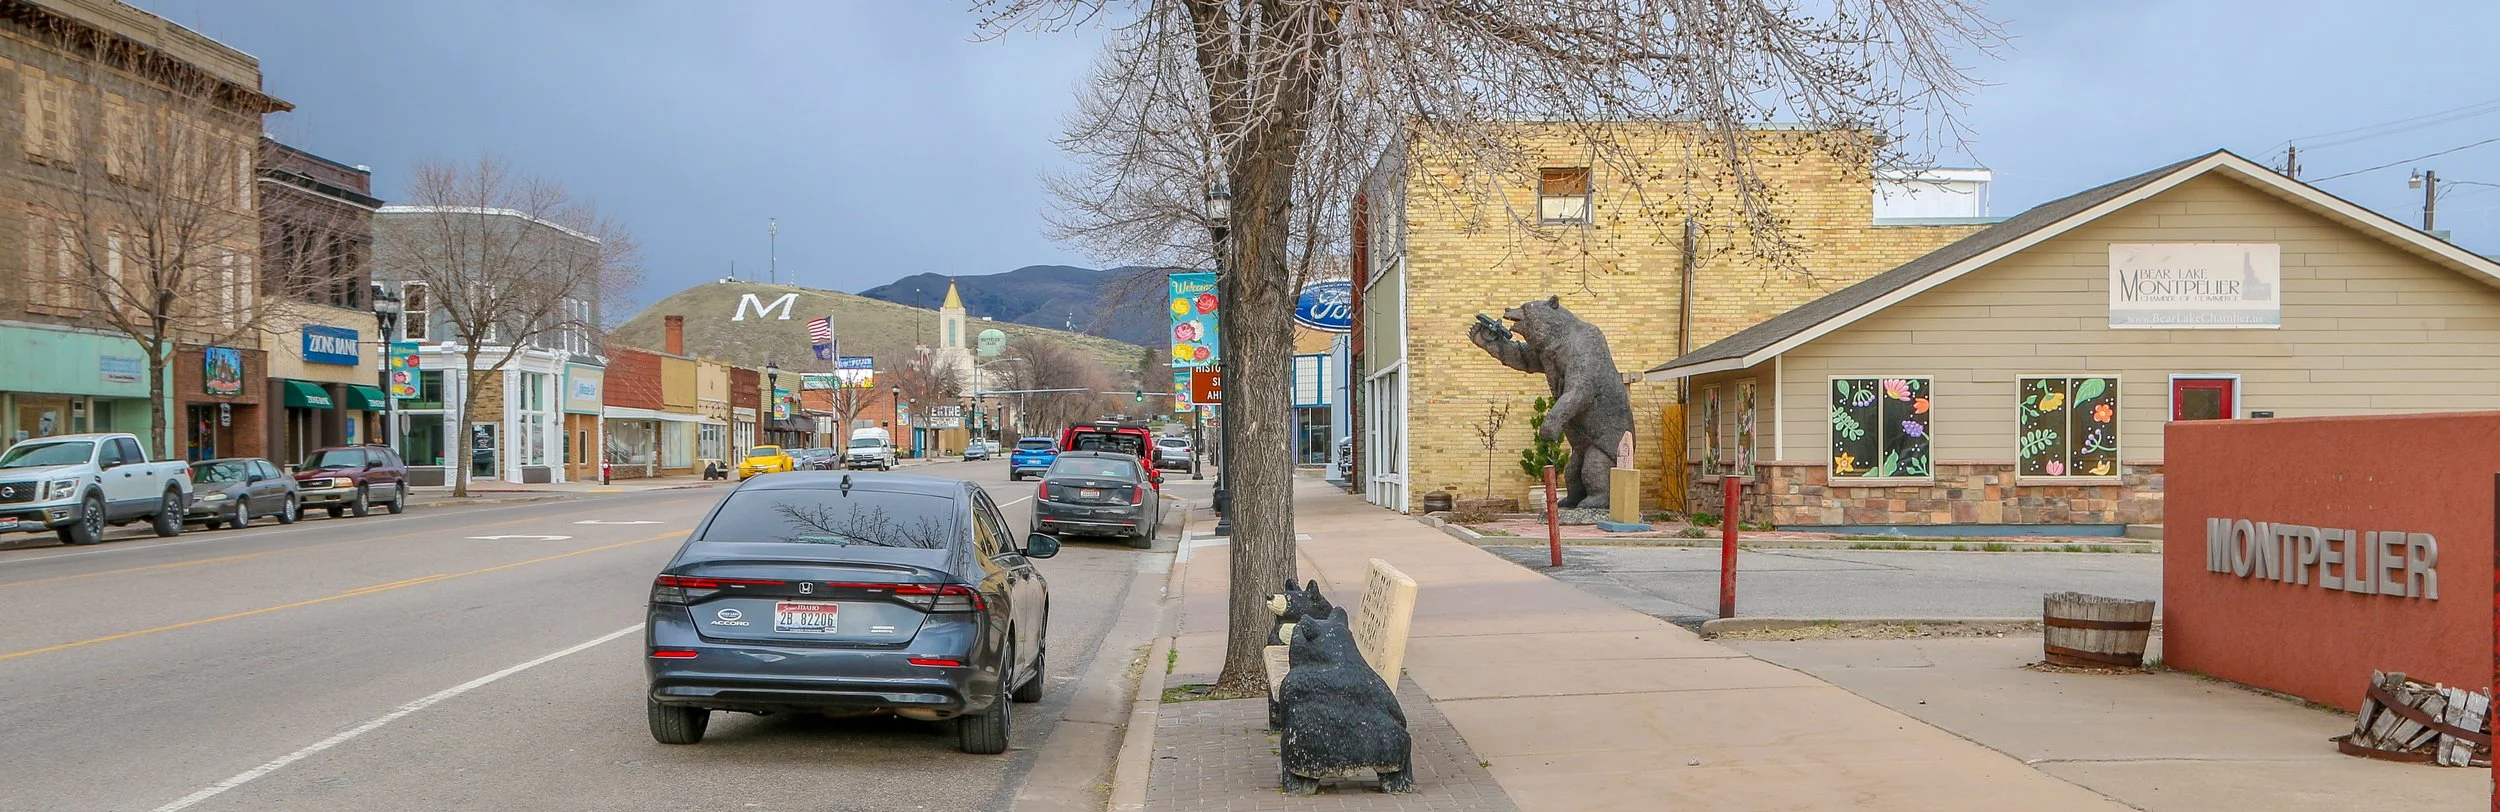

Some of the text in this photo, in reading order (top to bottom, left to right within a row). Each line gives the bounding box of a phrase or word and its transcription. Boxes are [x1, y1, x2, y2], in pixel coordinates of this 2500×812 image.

[2119, 269, 2240, 302] MONTPELIER
[2140, 269, 2208, 280] BEAR LAKE
[732, 293, 800, 321] M
[2127, 313, 2264, 324] www.BearLakeChamber.us
[309, 334, 359, 356] ZIONS BANK
[2207, 518, 2439, 600] MONTPELIER
[780, 612, 834, 627] 2B 82206
